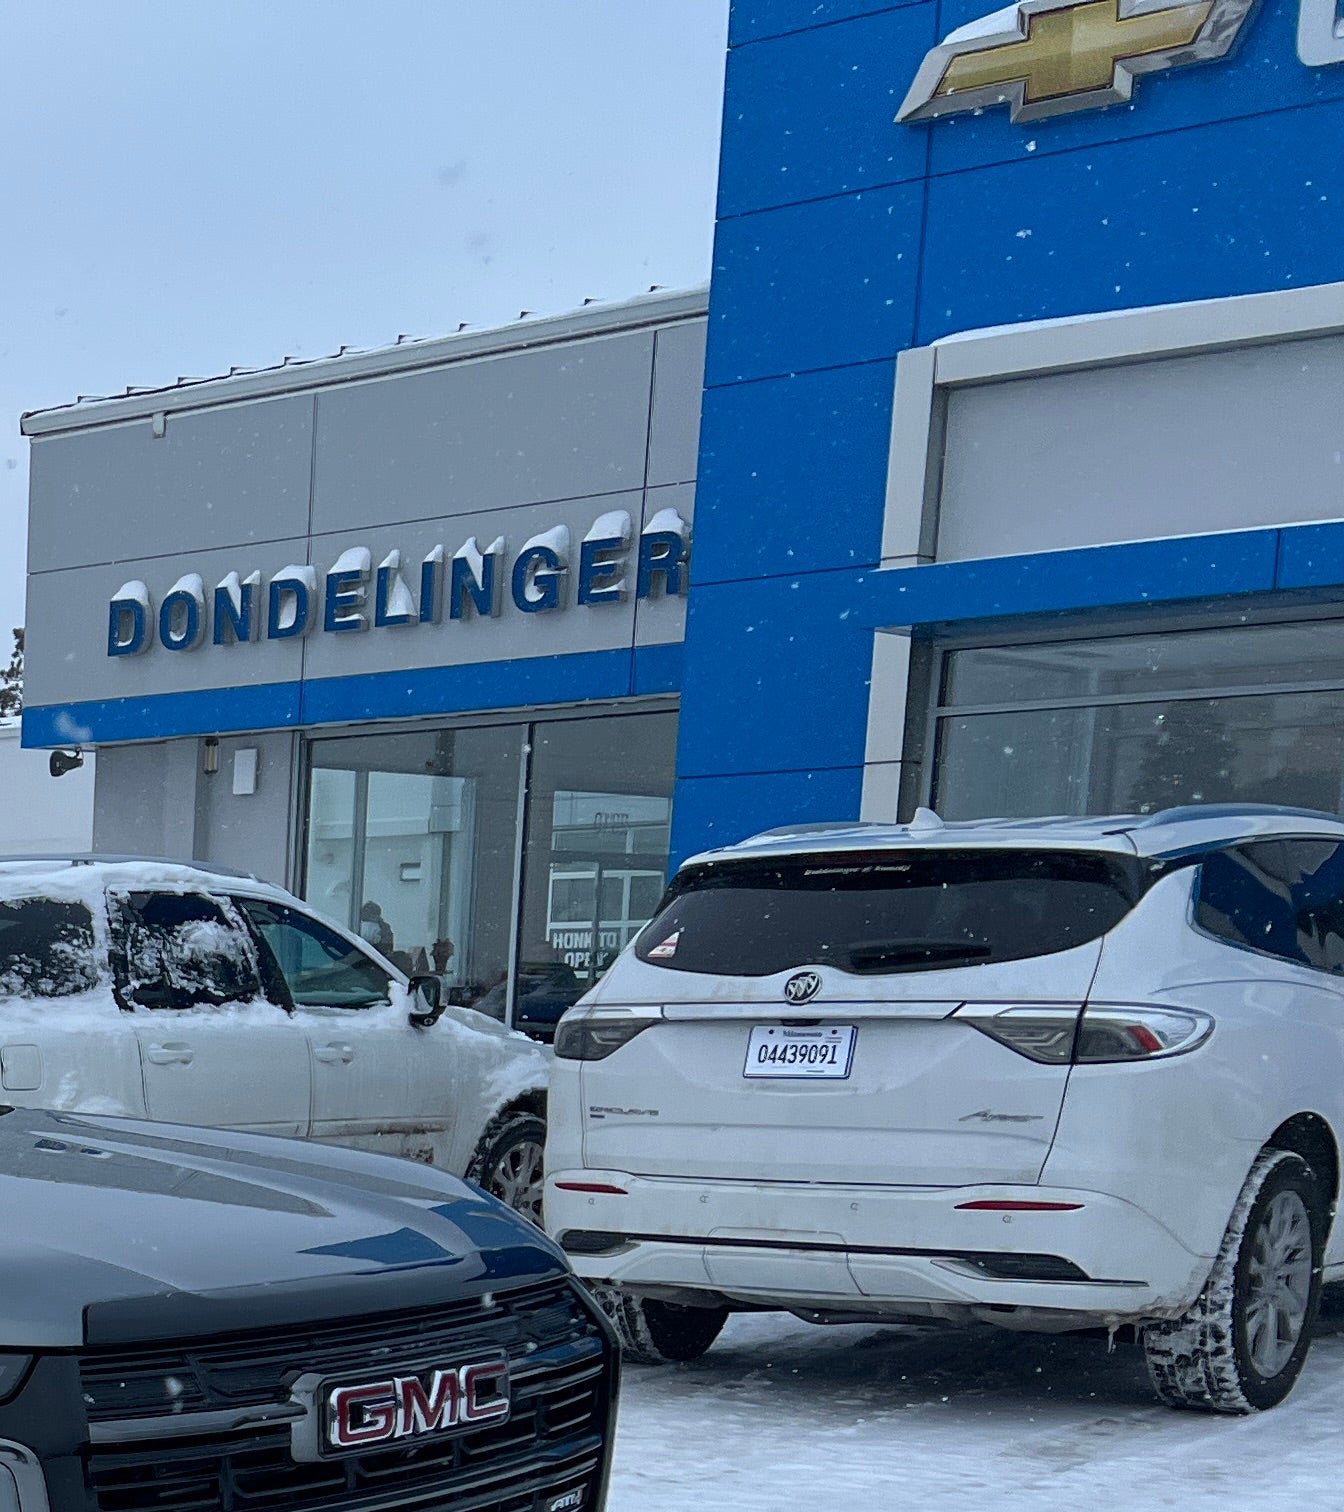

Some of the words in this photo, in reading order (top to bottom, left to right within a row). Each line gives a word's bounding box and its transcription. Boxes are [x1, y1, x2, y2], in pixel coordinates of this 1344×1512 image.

[108, 530, 683, 657] DONDELINGER
[599, 932, 617, 948] TO
[758, 1044, 837, 1064] 04439091
[330, 1360, 510, 1447] GMC
